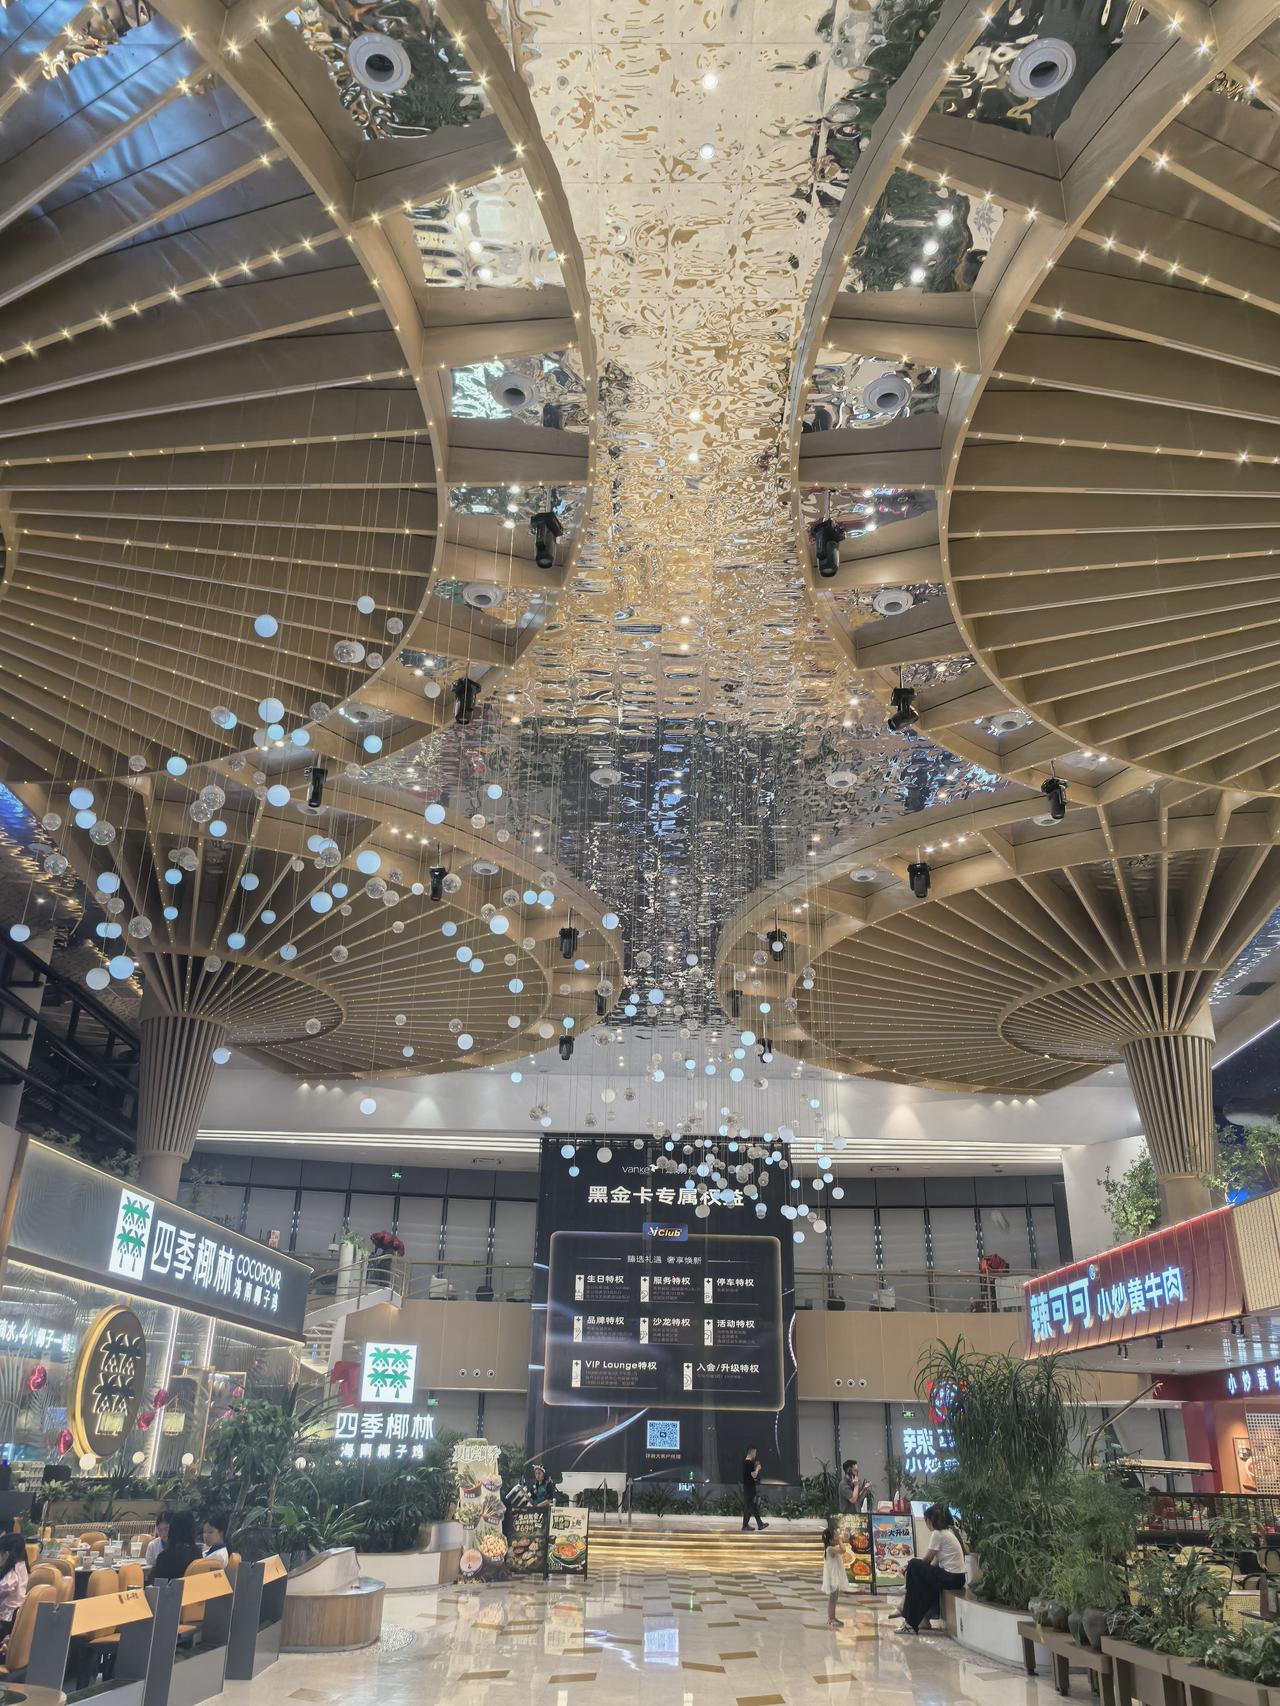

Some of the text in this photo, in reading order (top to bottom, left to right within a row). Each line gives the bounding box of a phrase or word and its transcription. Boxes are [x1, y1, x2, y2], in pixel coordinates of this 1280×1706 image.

[150, 1219, 235, 1296] 四季椰林
[236, 1254, 282, 1291] COCOFOUR
[586, 1275, 624, 1284] 生日特权
[653, 1277, 691, 1286] 服务特权
[716, 1278, 755, 1287] 停车特权
[1096, 1266, 1184, 1322] 小炒黄牛肉
[1030, 1277, 1092, 1344] 辣可可
[586, 1316, 625, 1325] 品牌特权
[652, 1318, 691, 1327] 沙龙特权
[717, 1320, 755, 1329] 活动特权
[585, 1361, 600, 1369] VIP
[696, 1363, 760, 1373] 入会/升级特权
[334, 1412, 435, 1440] 四季椰林
[339, 1442, 425, 1459] 海南椰子鸡
